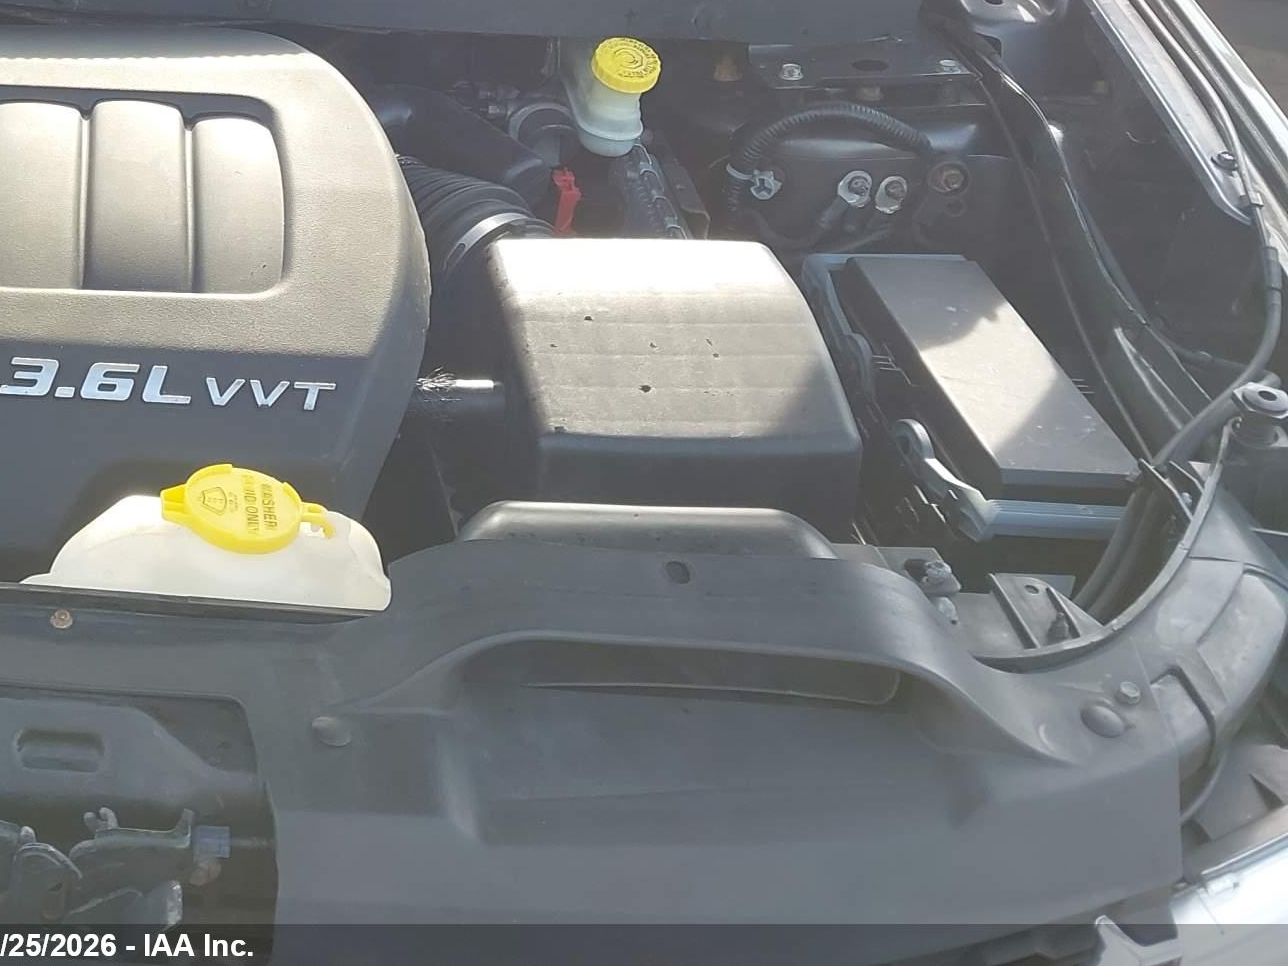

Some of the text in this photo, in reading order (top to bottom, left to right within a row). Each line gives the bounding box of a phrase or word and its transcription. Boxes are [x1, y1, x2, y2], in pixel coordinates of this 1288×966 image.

[205, 377, 337, 411] VVT
[245, 505, 261, 536] ONLY
[260, 483, 277, 531] WASHER
